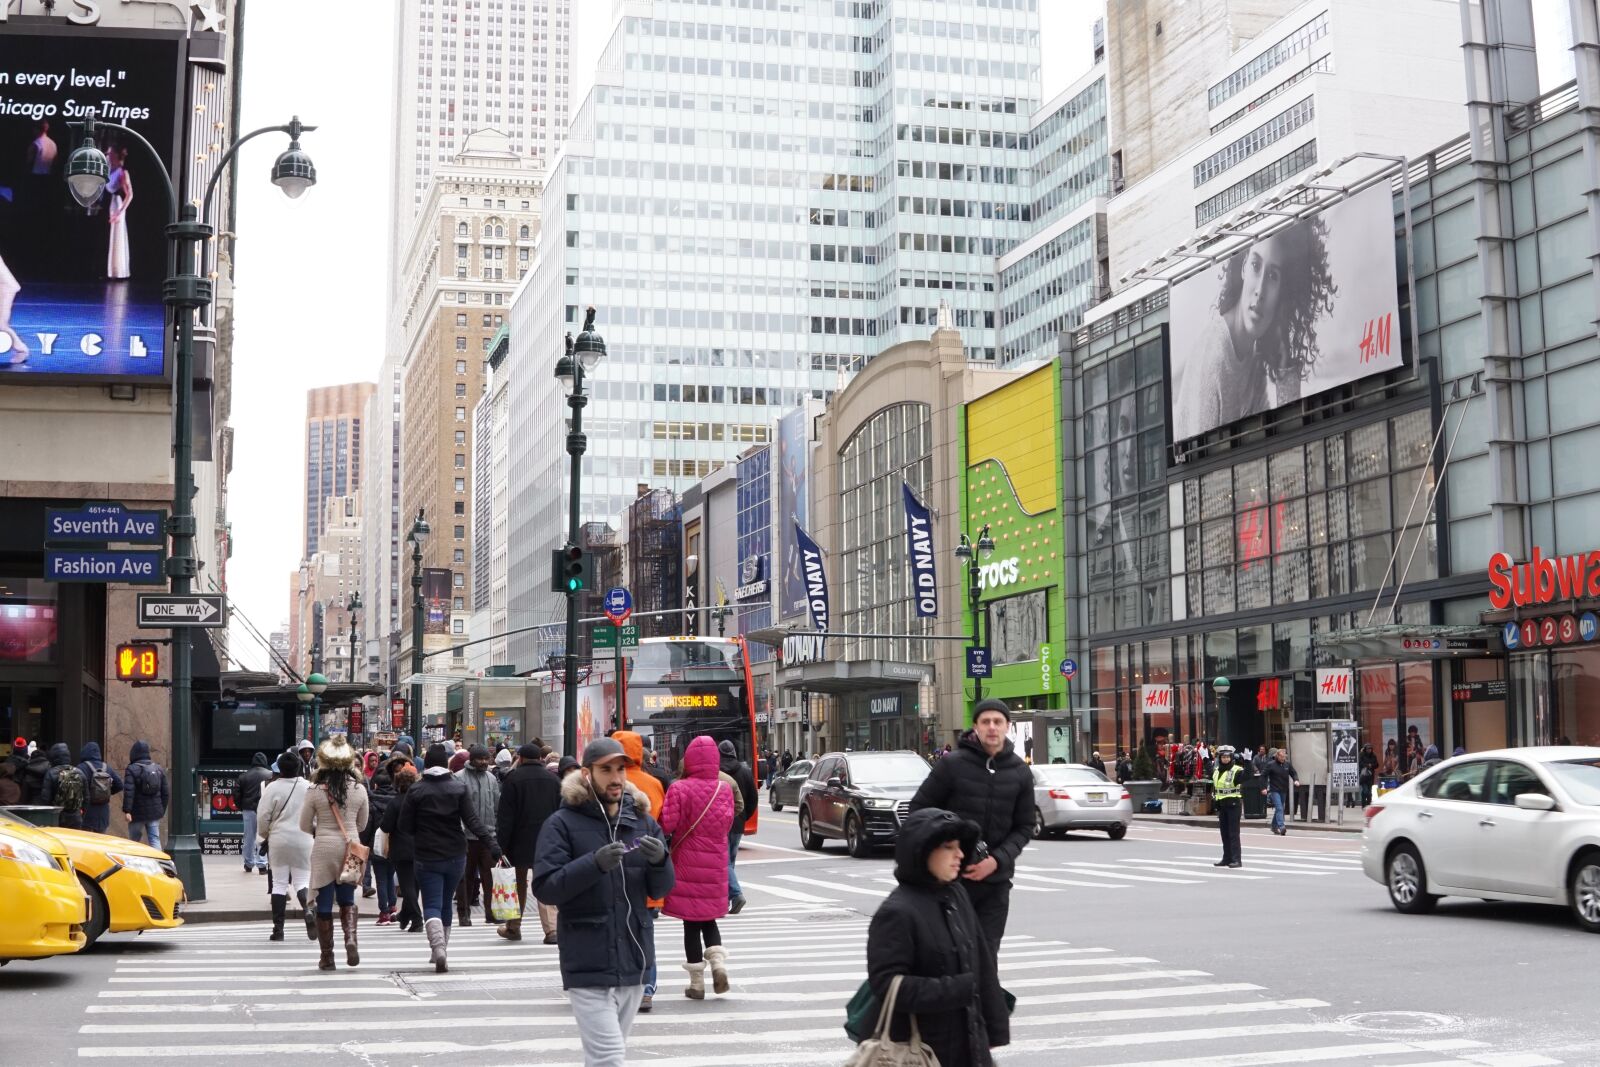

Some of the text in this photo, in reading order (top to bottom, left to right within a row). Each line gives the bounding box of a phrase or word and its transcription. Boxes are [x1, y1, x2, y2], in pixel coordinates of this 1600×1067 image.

[15, 72, 66, 91] every
[70, 67, 126, 88] level."
[62, 99, 150, 120] Sun-Times
[1359, 311, 1391, 364] H&M
[53, 517, 155, 535] Seventh Ave
[54, 557, 152, 575] Fashion Ave
[803, 549, 825, 596] NAVY
[910, 513, 937, 613] OLD NAVY
[735, 580, 767, 600] SKECHERS
[153, 604, 210, 615] ONE WAY
[1580, 619, 1595, 637] MTA
[796, 635, 825, 665] NAVY
[141, 652, 155, 675] 13
[893, 666, 906, 674] OLD
[1321, 674, 1348, 695] H&M
[644, 696, 718, 708] THE SIGHTSEEING BUS
[870, 696, 898, 714] OLD NAVY
[1146, 689, 1168, 707] H&M
